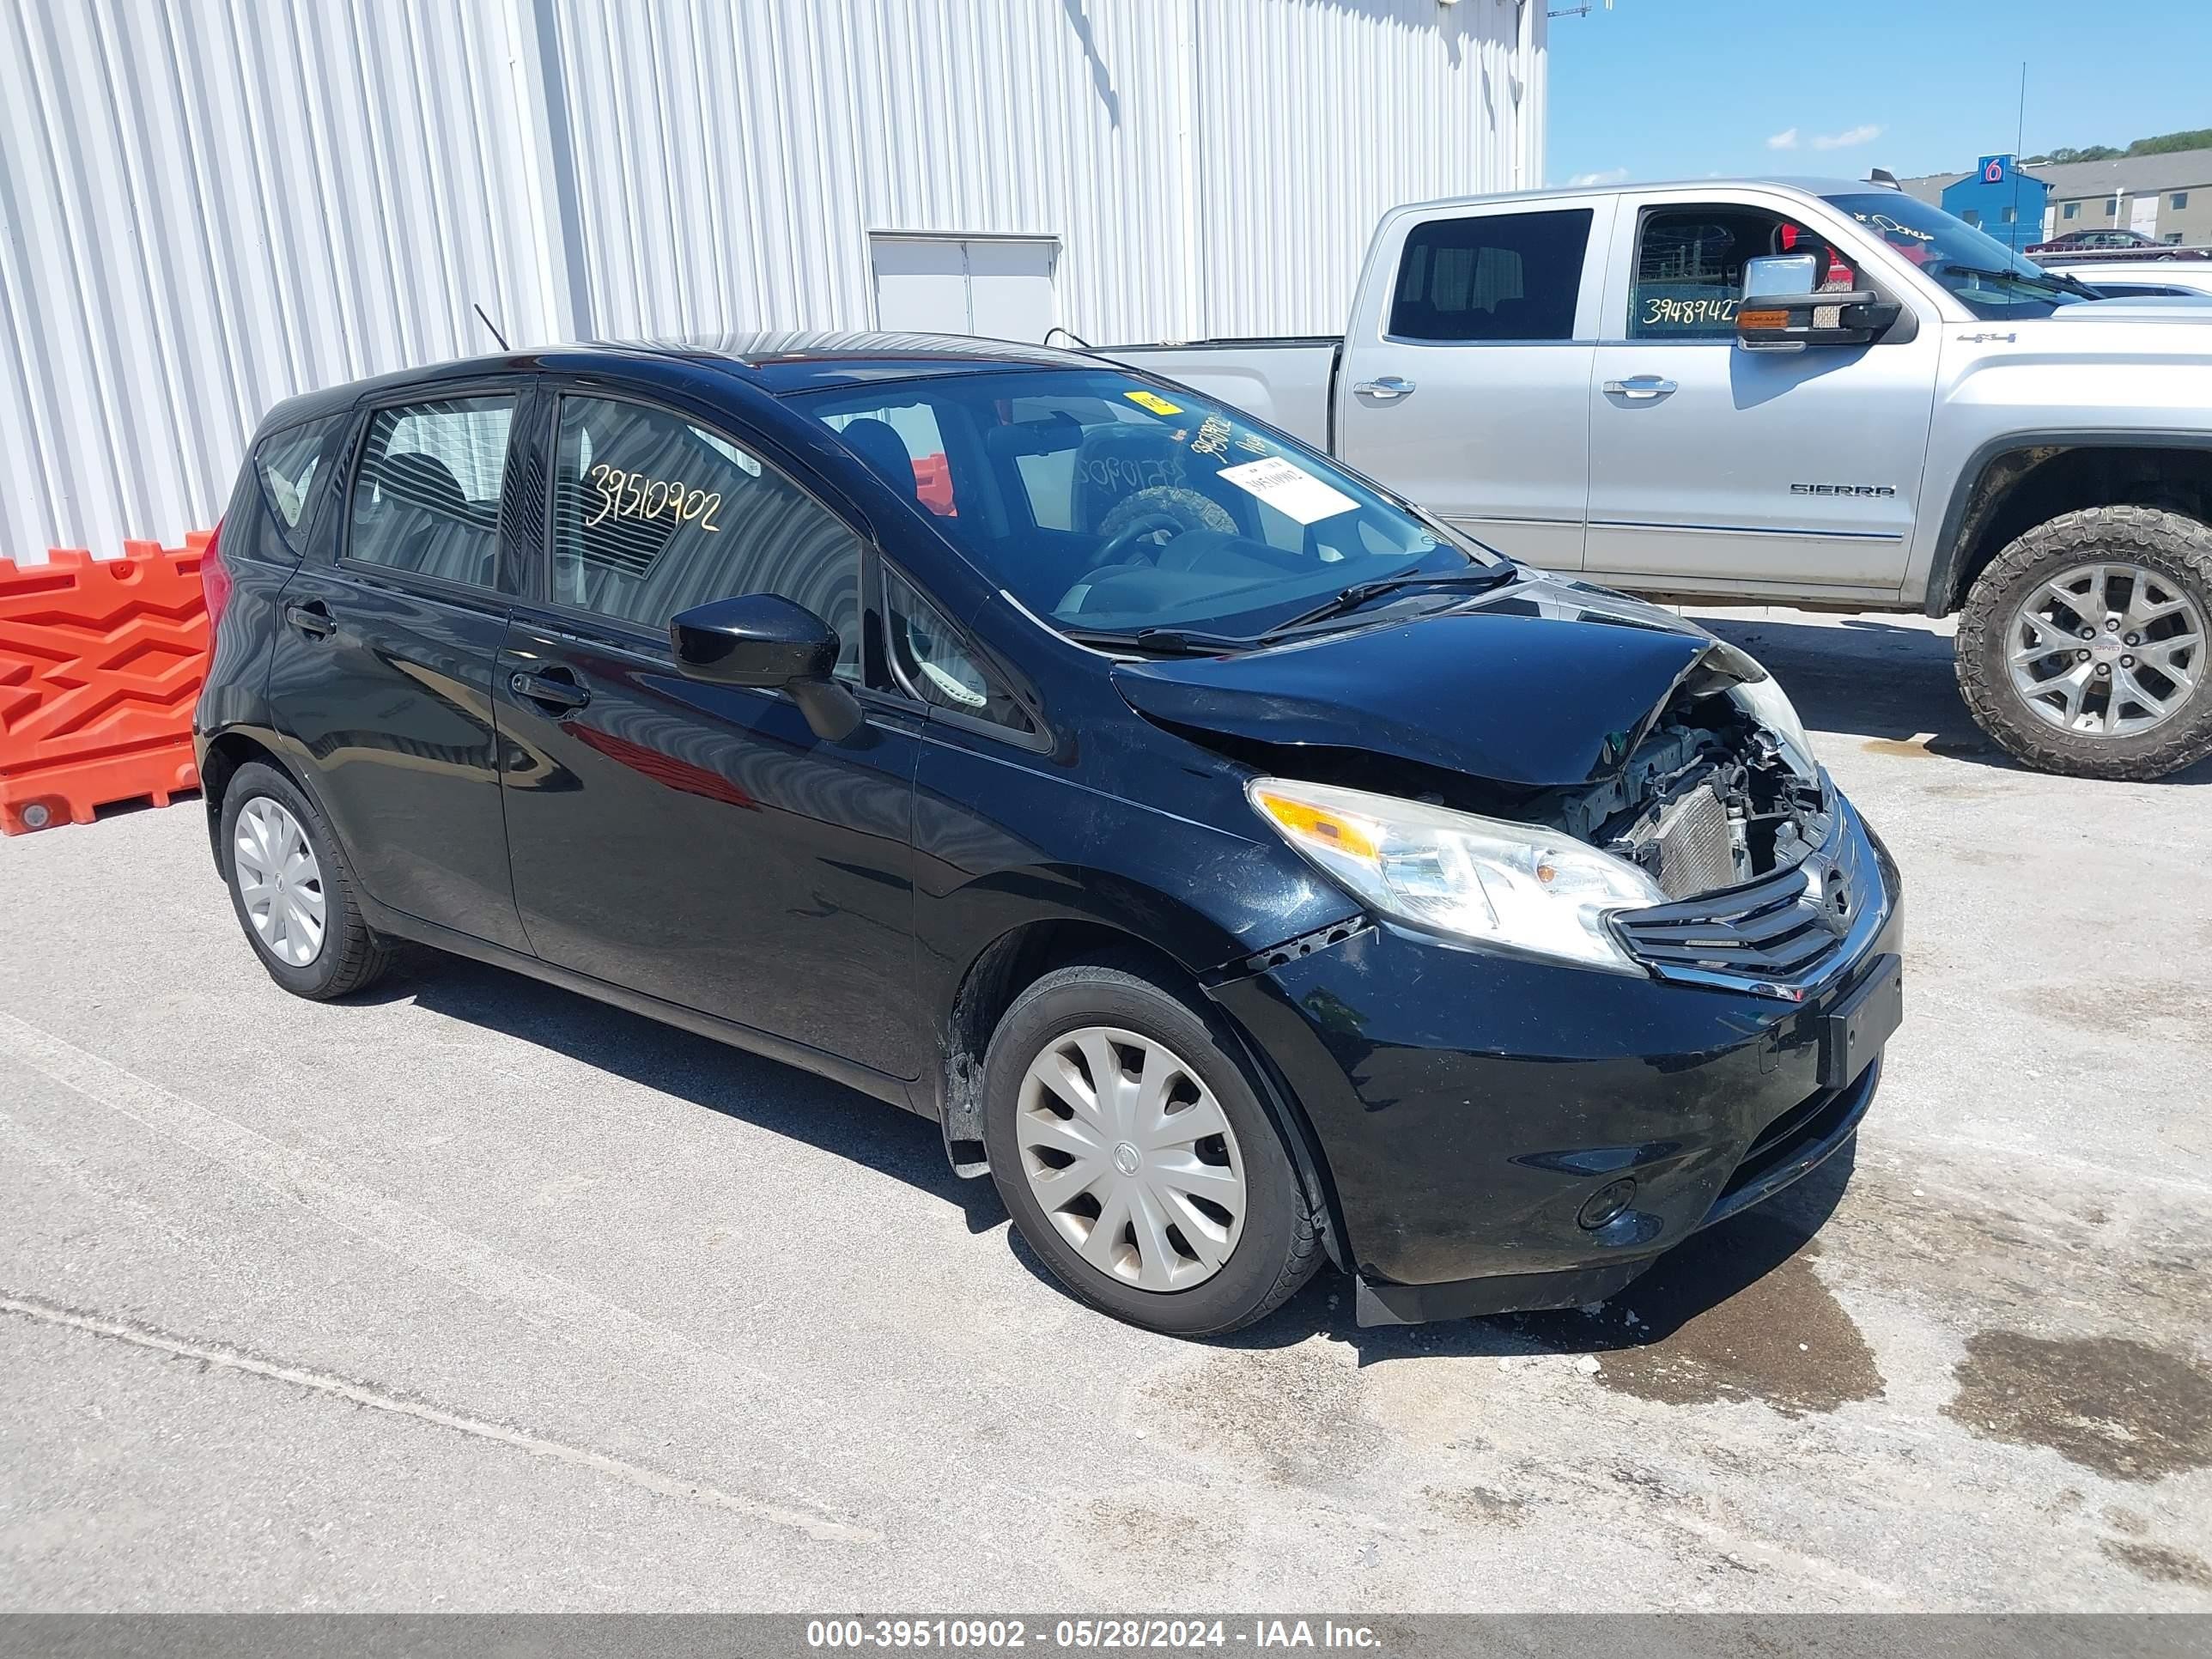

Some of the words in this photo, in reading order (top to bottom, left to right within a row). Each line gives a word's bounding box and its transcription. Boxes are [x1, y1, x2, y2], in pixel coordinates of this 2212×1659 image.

[1985, 158, 2002, 182] 6
[586, 464, 721, 532] 39510902
[1790, 483, 1897, 498] SIERRA
